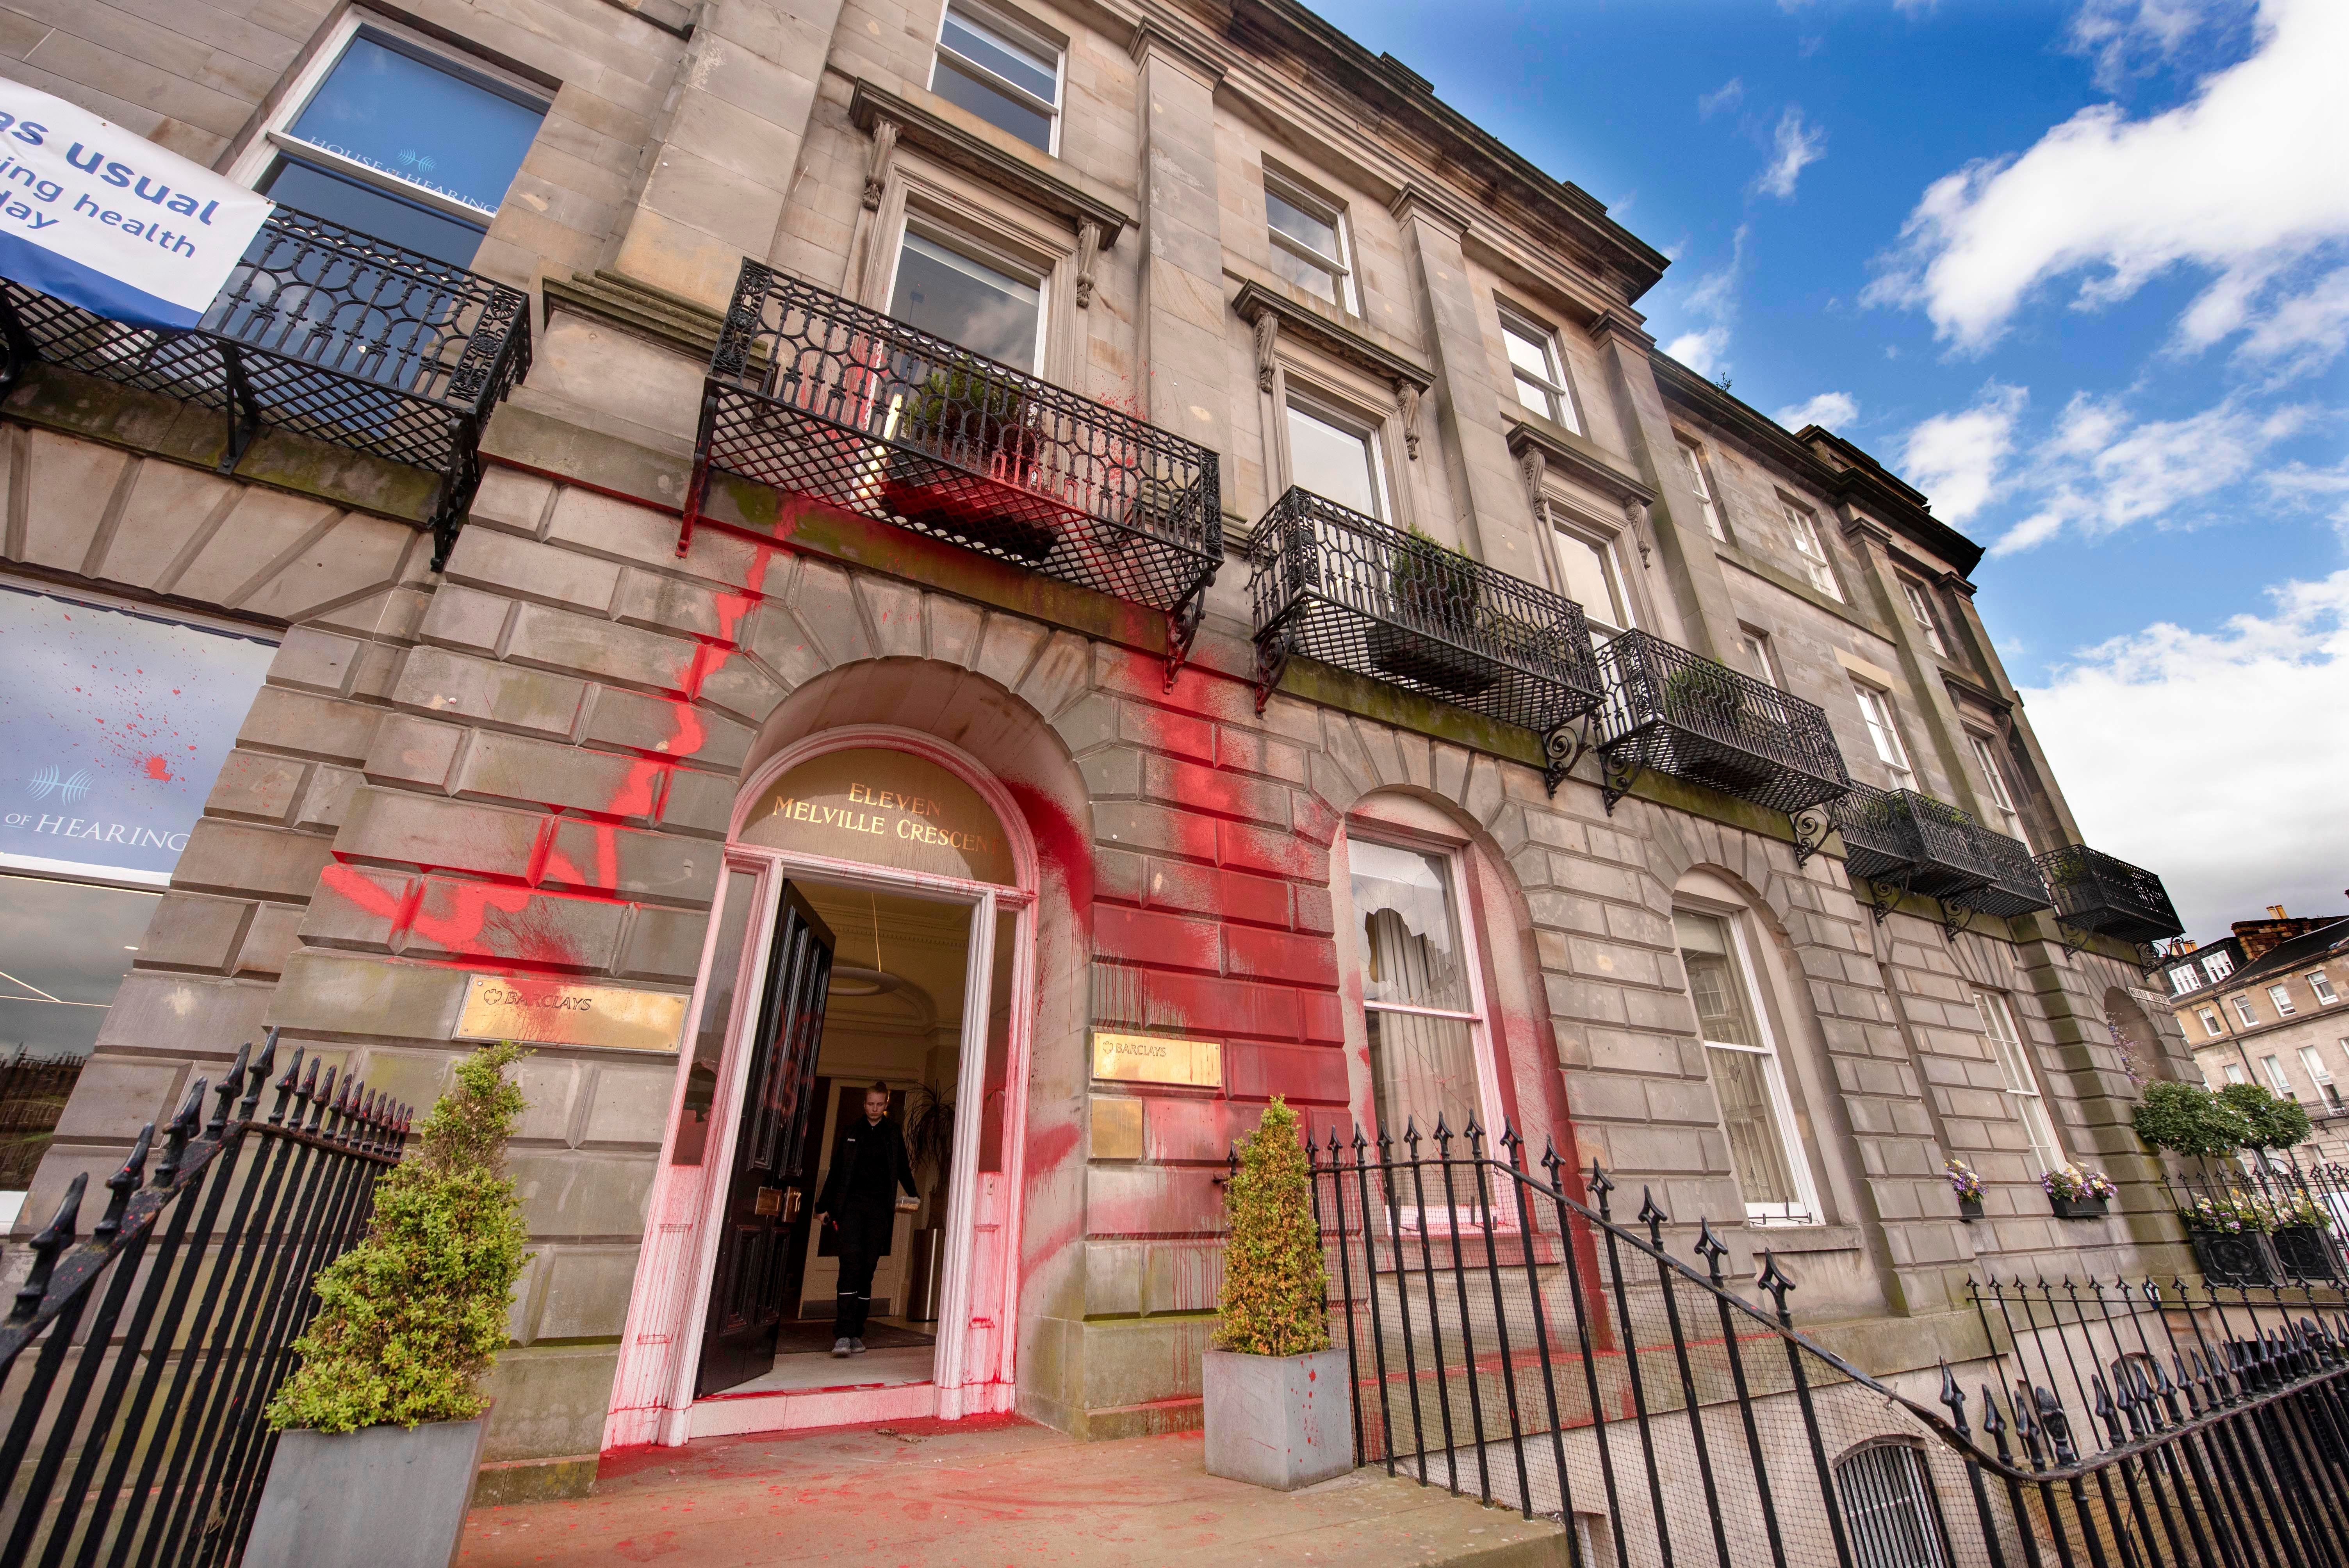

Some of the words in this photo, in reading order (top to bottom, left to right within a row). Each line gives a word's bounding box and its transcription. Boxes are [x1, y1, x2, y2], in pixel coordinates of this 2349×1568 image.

[66, 142, 220, 226] usual
[406, 173, 499, 215] HEARING
[0, 157, 64, 203] ing
[73, 193, 196, 258] health
[848, 782, 941, 817] ELEVEN
[5, 813, 32, 825] OF
[34, 814, 191, 852] HEARING
[772, 796, 885, 835] MELVILLE
[897, 819, 1000, 855] CRESCENT
[504, 992, 592, 1011] BARCLAYS
[1116, 1043, 1166, 1057] BARCLAYS
